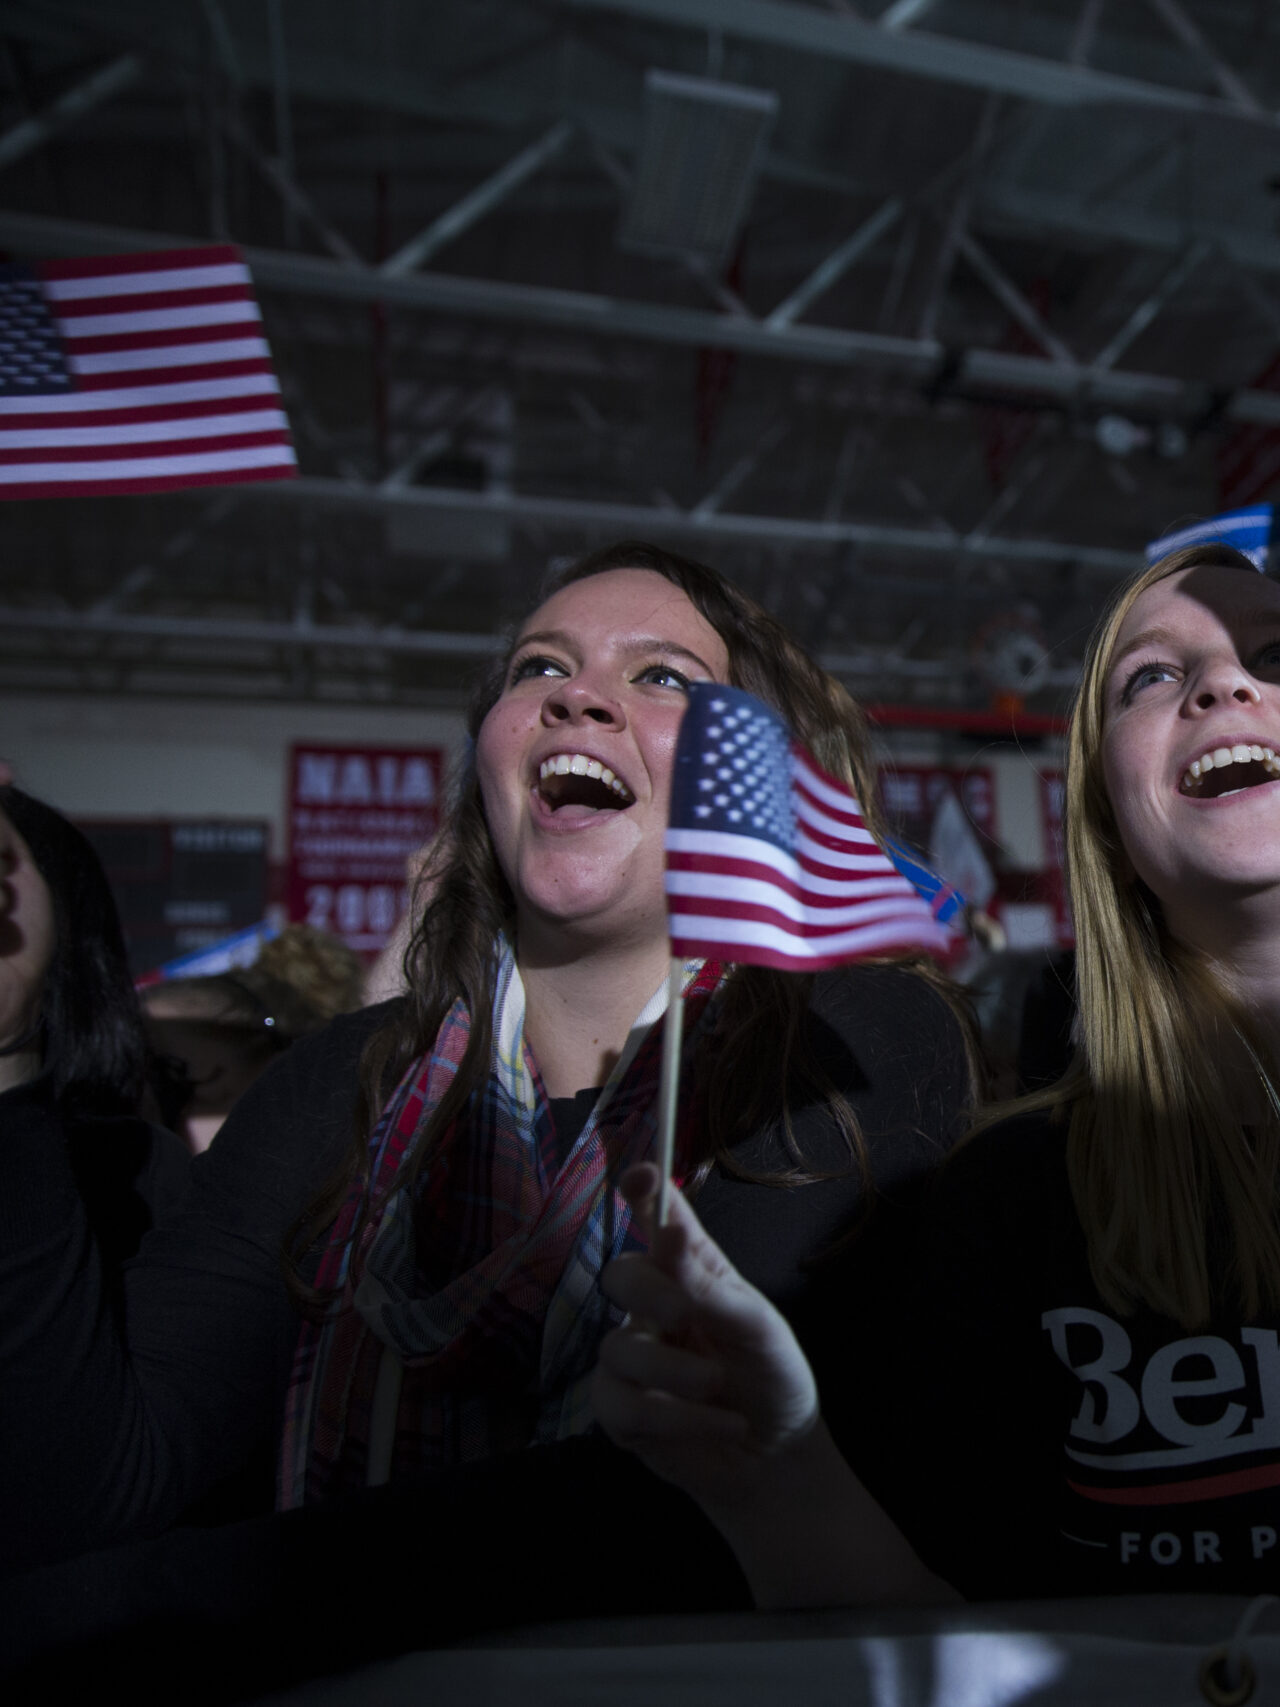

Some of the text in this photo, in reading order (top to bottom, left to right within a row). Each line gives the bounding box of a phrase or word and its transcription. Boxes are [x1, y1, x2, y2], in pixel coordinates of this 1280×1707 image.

[300, 755, 435, 802] NAIA
[304, 884, 408, 932] 200
[1120, 1530, 1223, 1566] FOR
